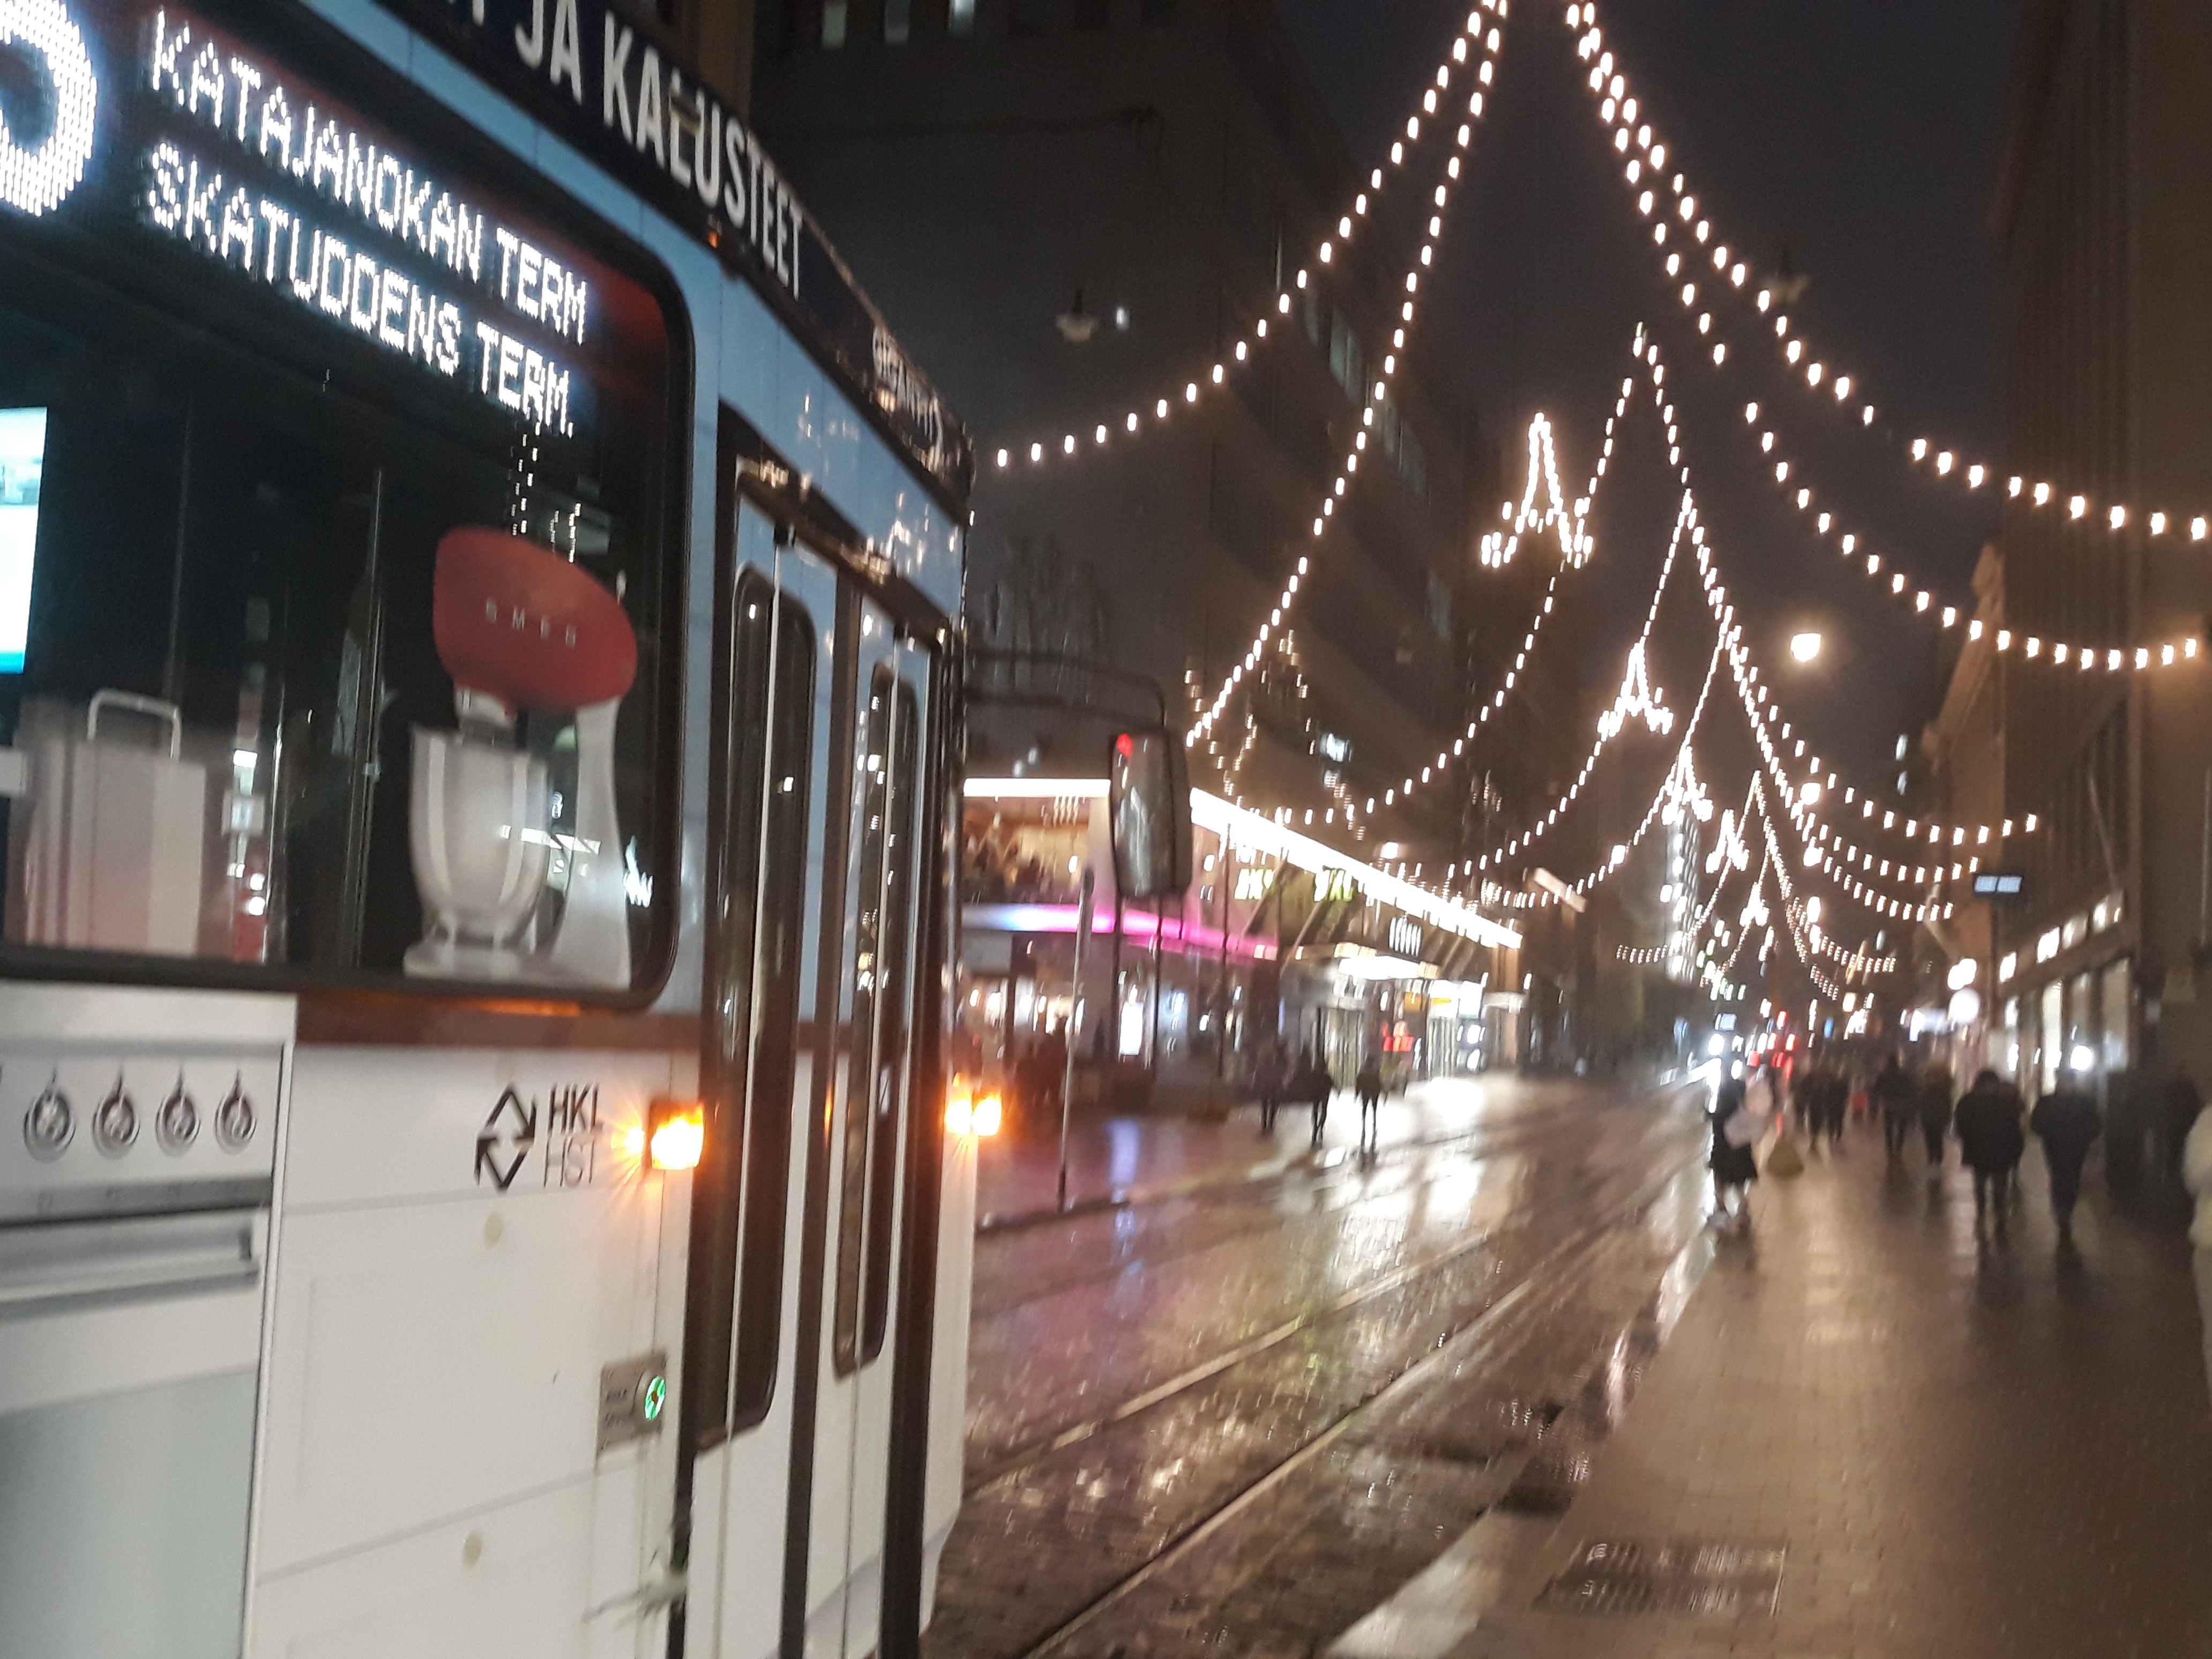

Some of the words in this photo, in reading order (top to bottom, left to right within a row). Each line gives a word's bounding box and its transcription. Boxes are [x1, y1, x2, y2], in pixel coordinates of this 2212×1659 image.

[148, 142, 462, 377] SKATUDDENS
[151, 8, 483, 285] KATAJANOKAN
[496, 227, 588, 347] TERM
[515, 0, 583, 106] JA
[603, 8, 804, 303] KALUSTEET
[548, 1082, 604, 1135] HKL
